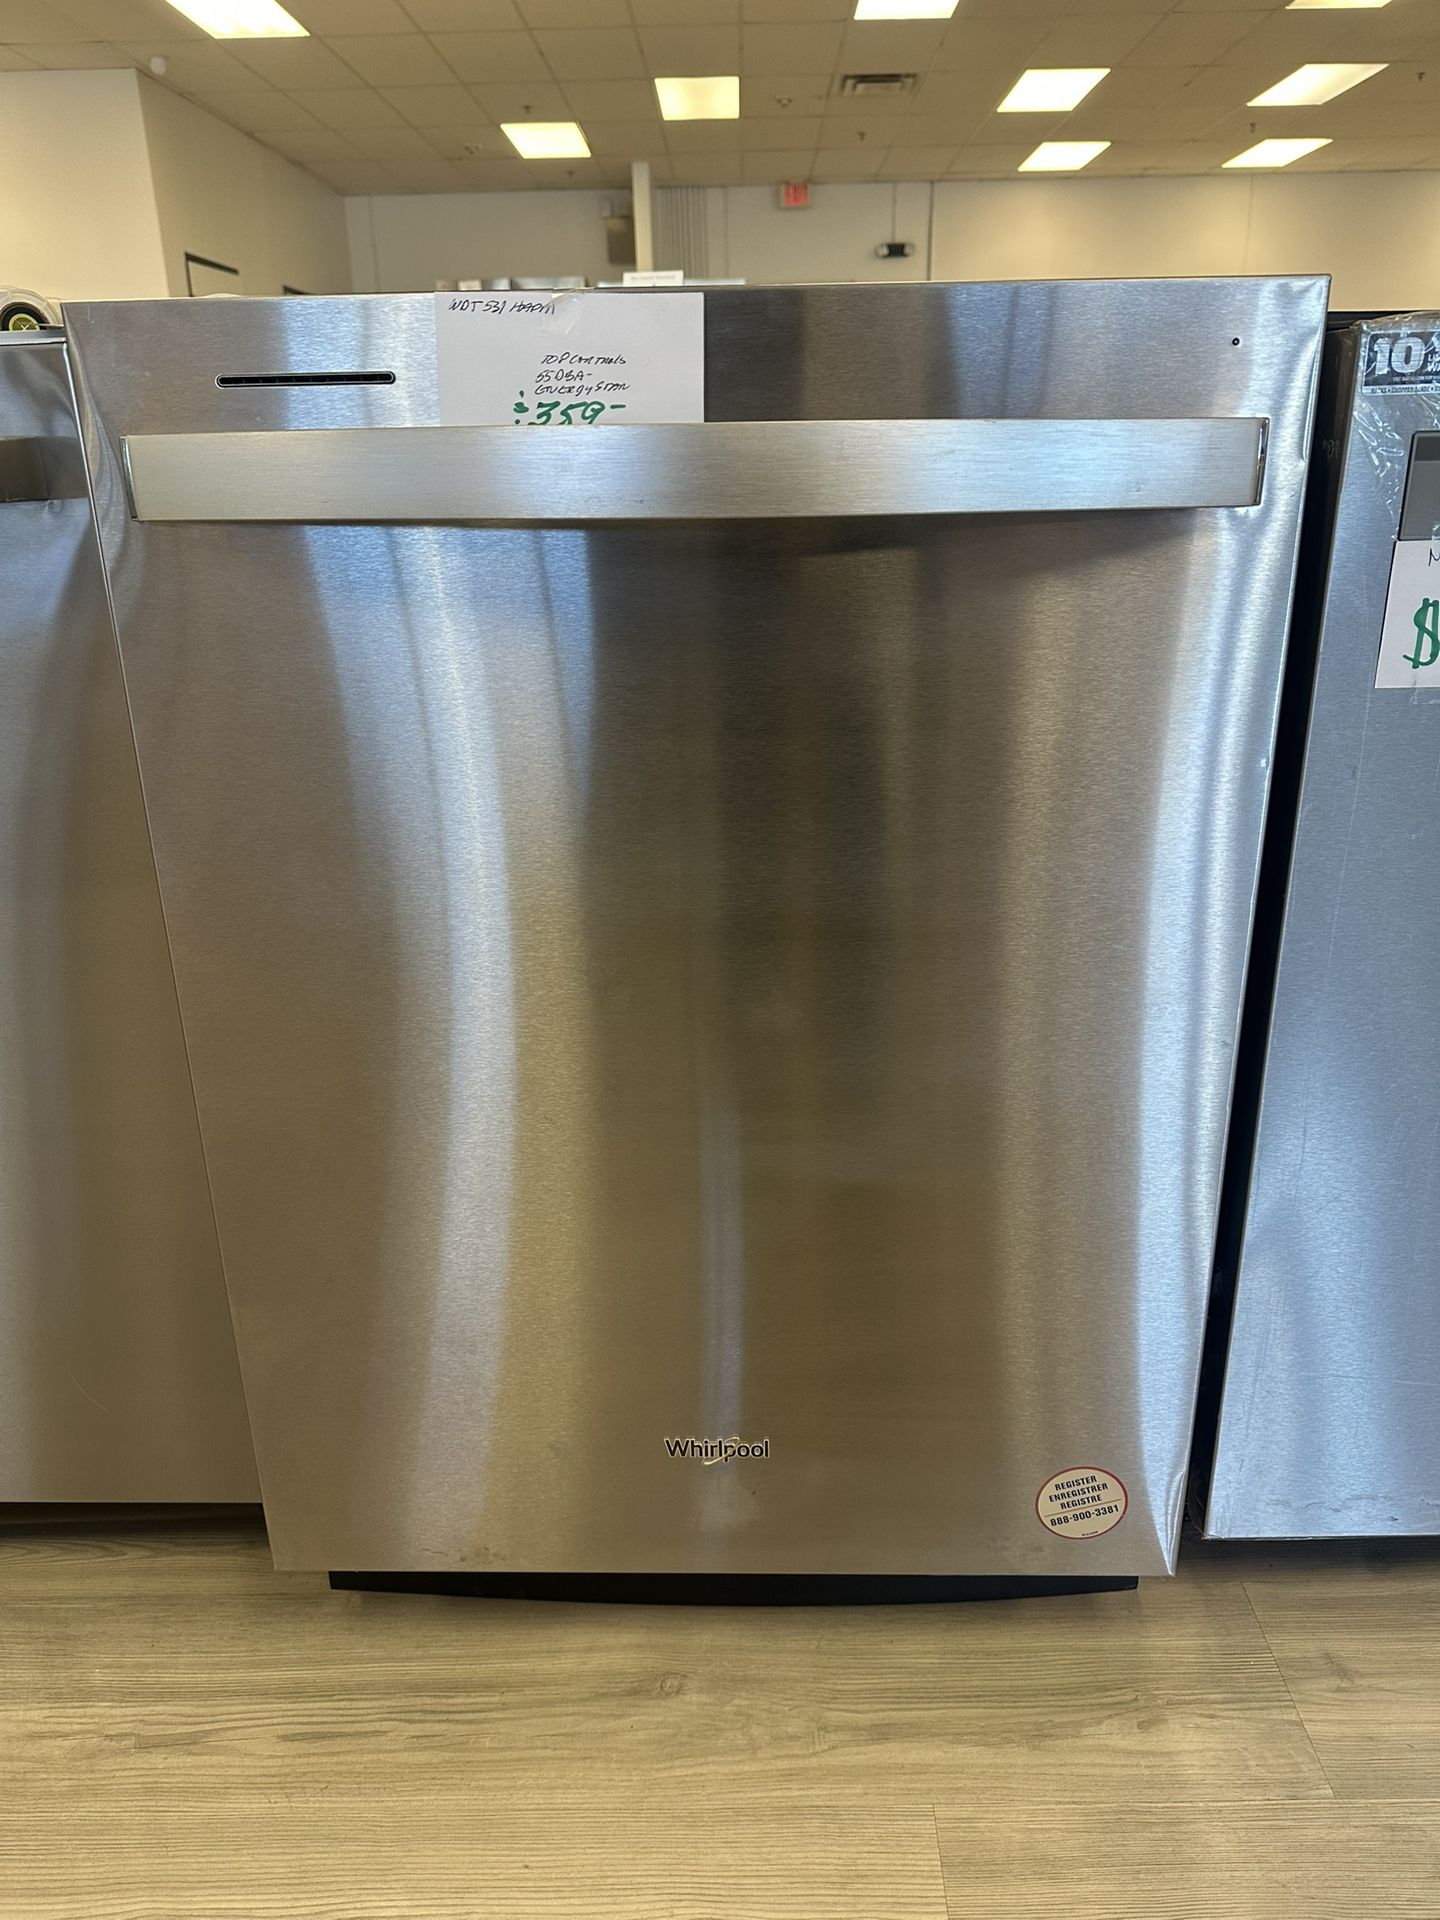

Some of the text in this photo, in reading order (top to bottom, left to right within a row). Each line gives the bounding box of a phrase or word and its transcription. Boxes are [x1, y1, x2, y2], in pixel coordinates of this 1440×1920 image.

[1373, 336, 1425, 375] 10
[664, 1438, 769, 1463] Whirlpool
[1048, 1482, 1109, 1502] ENREGISTRER
[1054, 1475, 1098, 1491] REGISTER
[1060, 1493, 1103, 1510] REGISTRE
[1049, 1504, 1120, 1527] 888-900-3381
